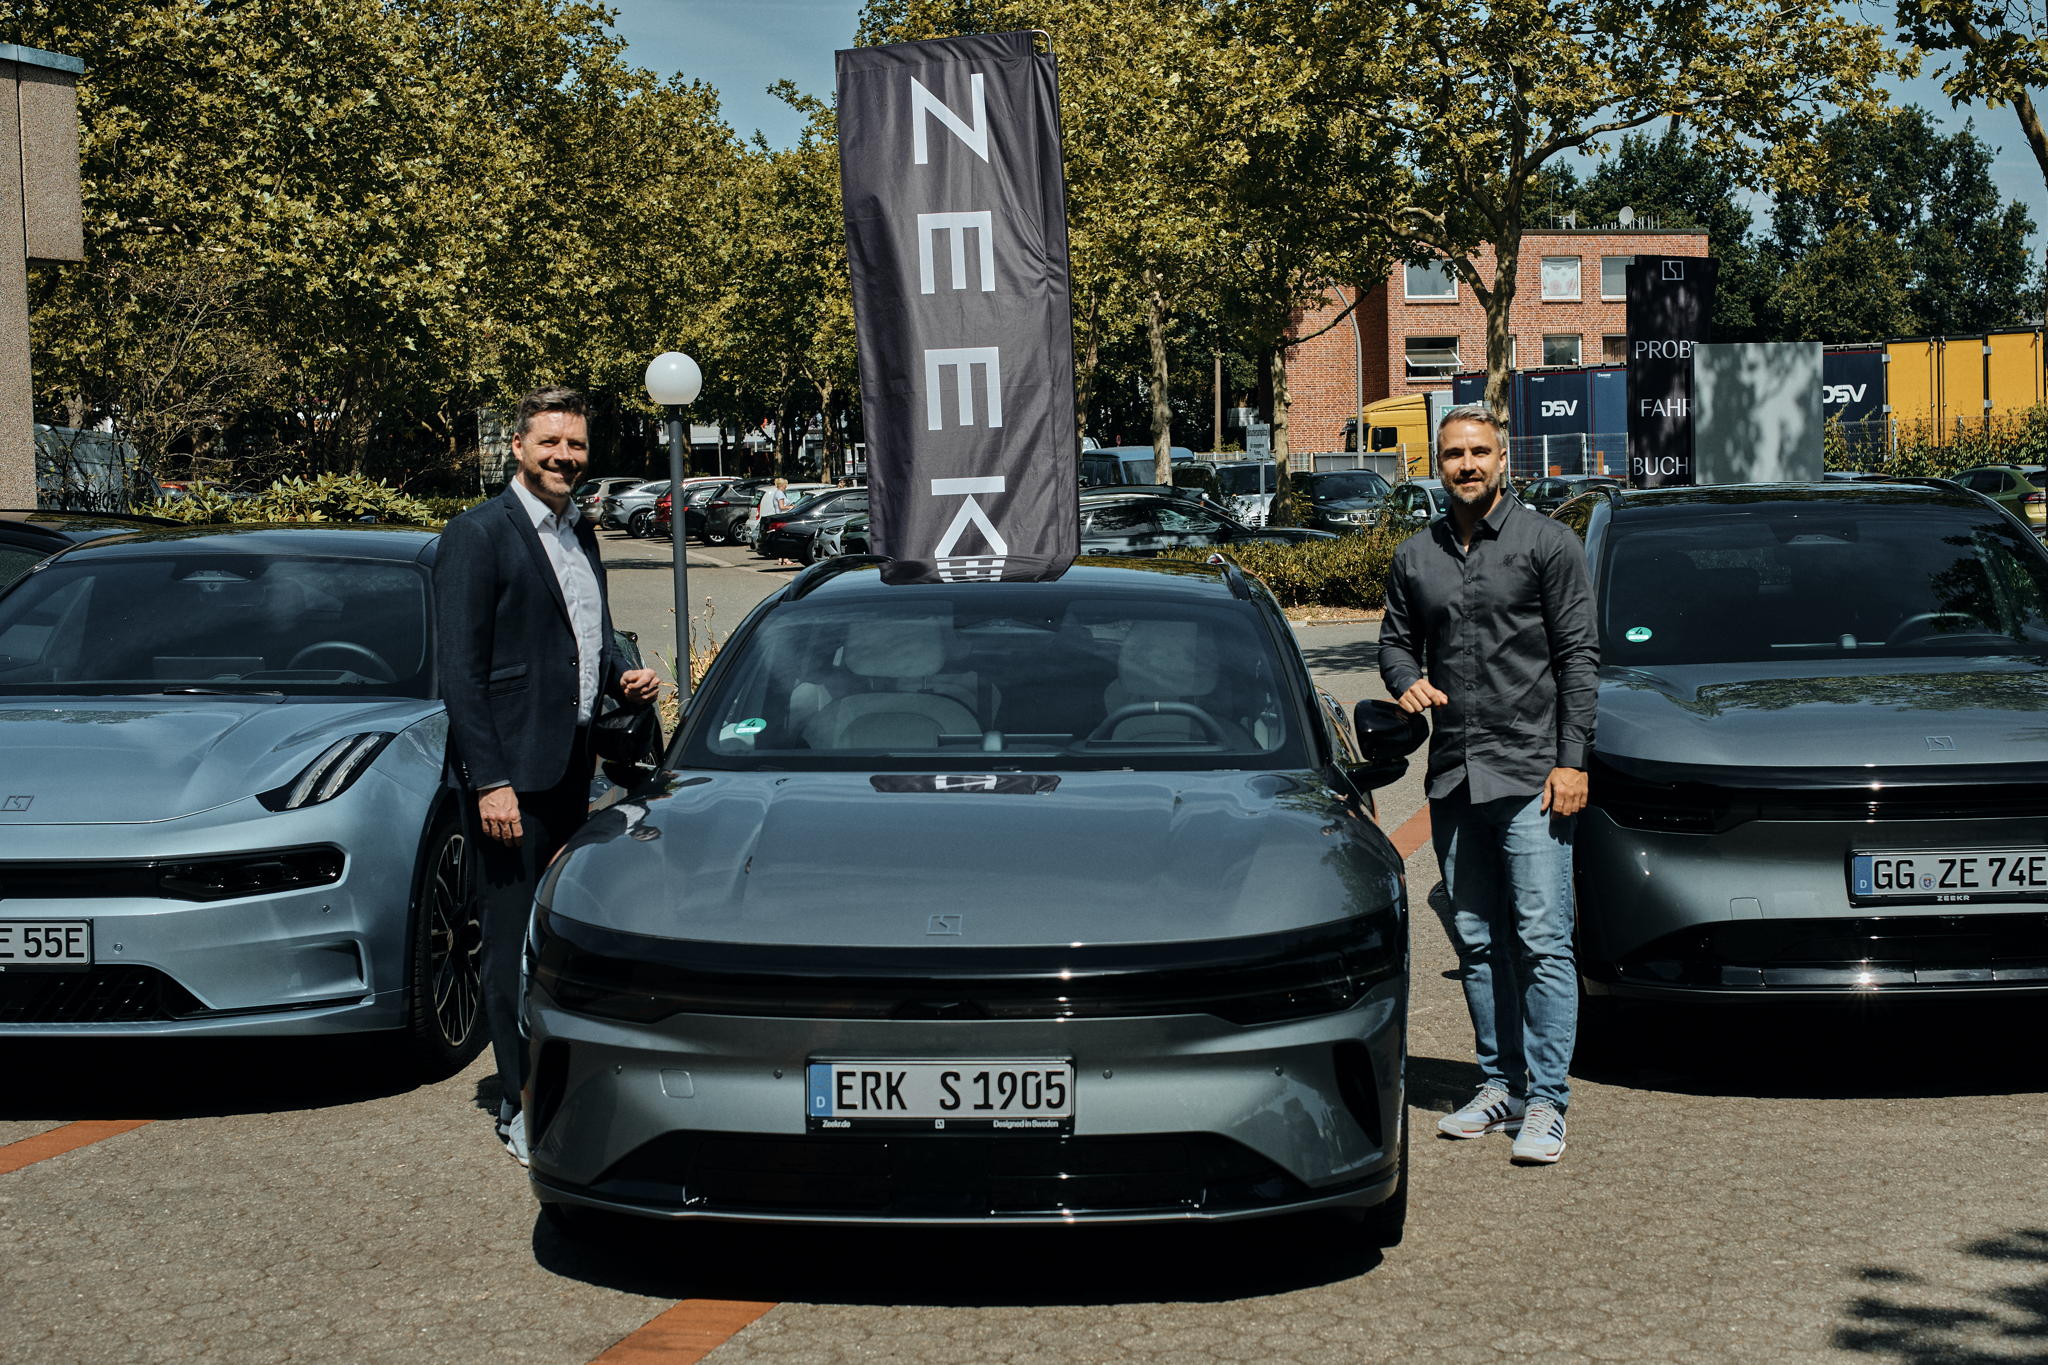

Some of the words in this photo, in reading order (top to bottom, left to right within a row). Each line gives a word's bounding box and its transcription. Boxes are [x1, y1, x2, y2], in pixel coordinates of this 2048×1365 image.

[1635, 339, 1700, 359] PROB
[1541, 399, 1578, 417] DSV
[746, 719, 756, 728] 4
[1873, 859, 1915, 889] GG
[1938, 858, 1979, 888] ZE
[1988, 856, 2047, 887] 74E
[1859, 880, 1867, 889] D
[24, 927, 85, 958] 55E
[836, 1071, 907, 1110] ERK
[939, 1071, 961, 1110] S
[973, 1071, 1066, 1110] 1905
[816, 1096, 825, 1108] D
[992, 1119, 1024, 1129] Designed
[1025, 1119, 1032, 1128] in
[1032, 1119, 1059, 1128] Sweden
